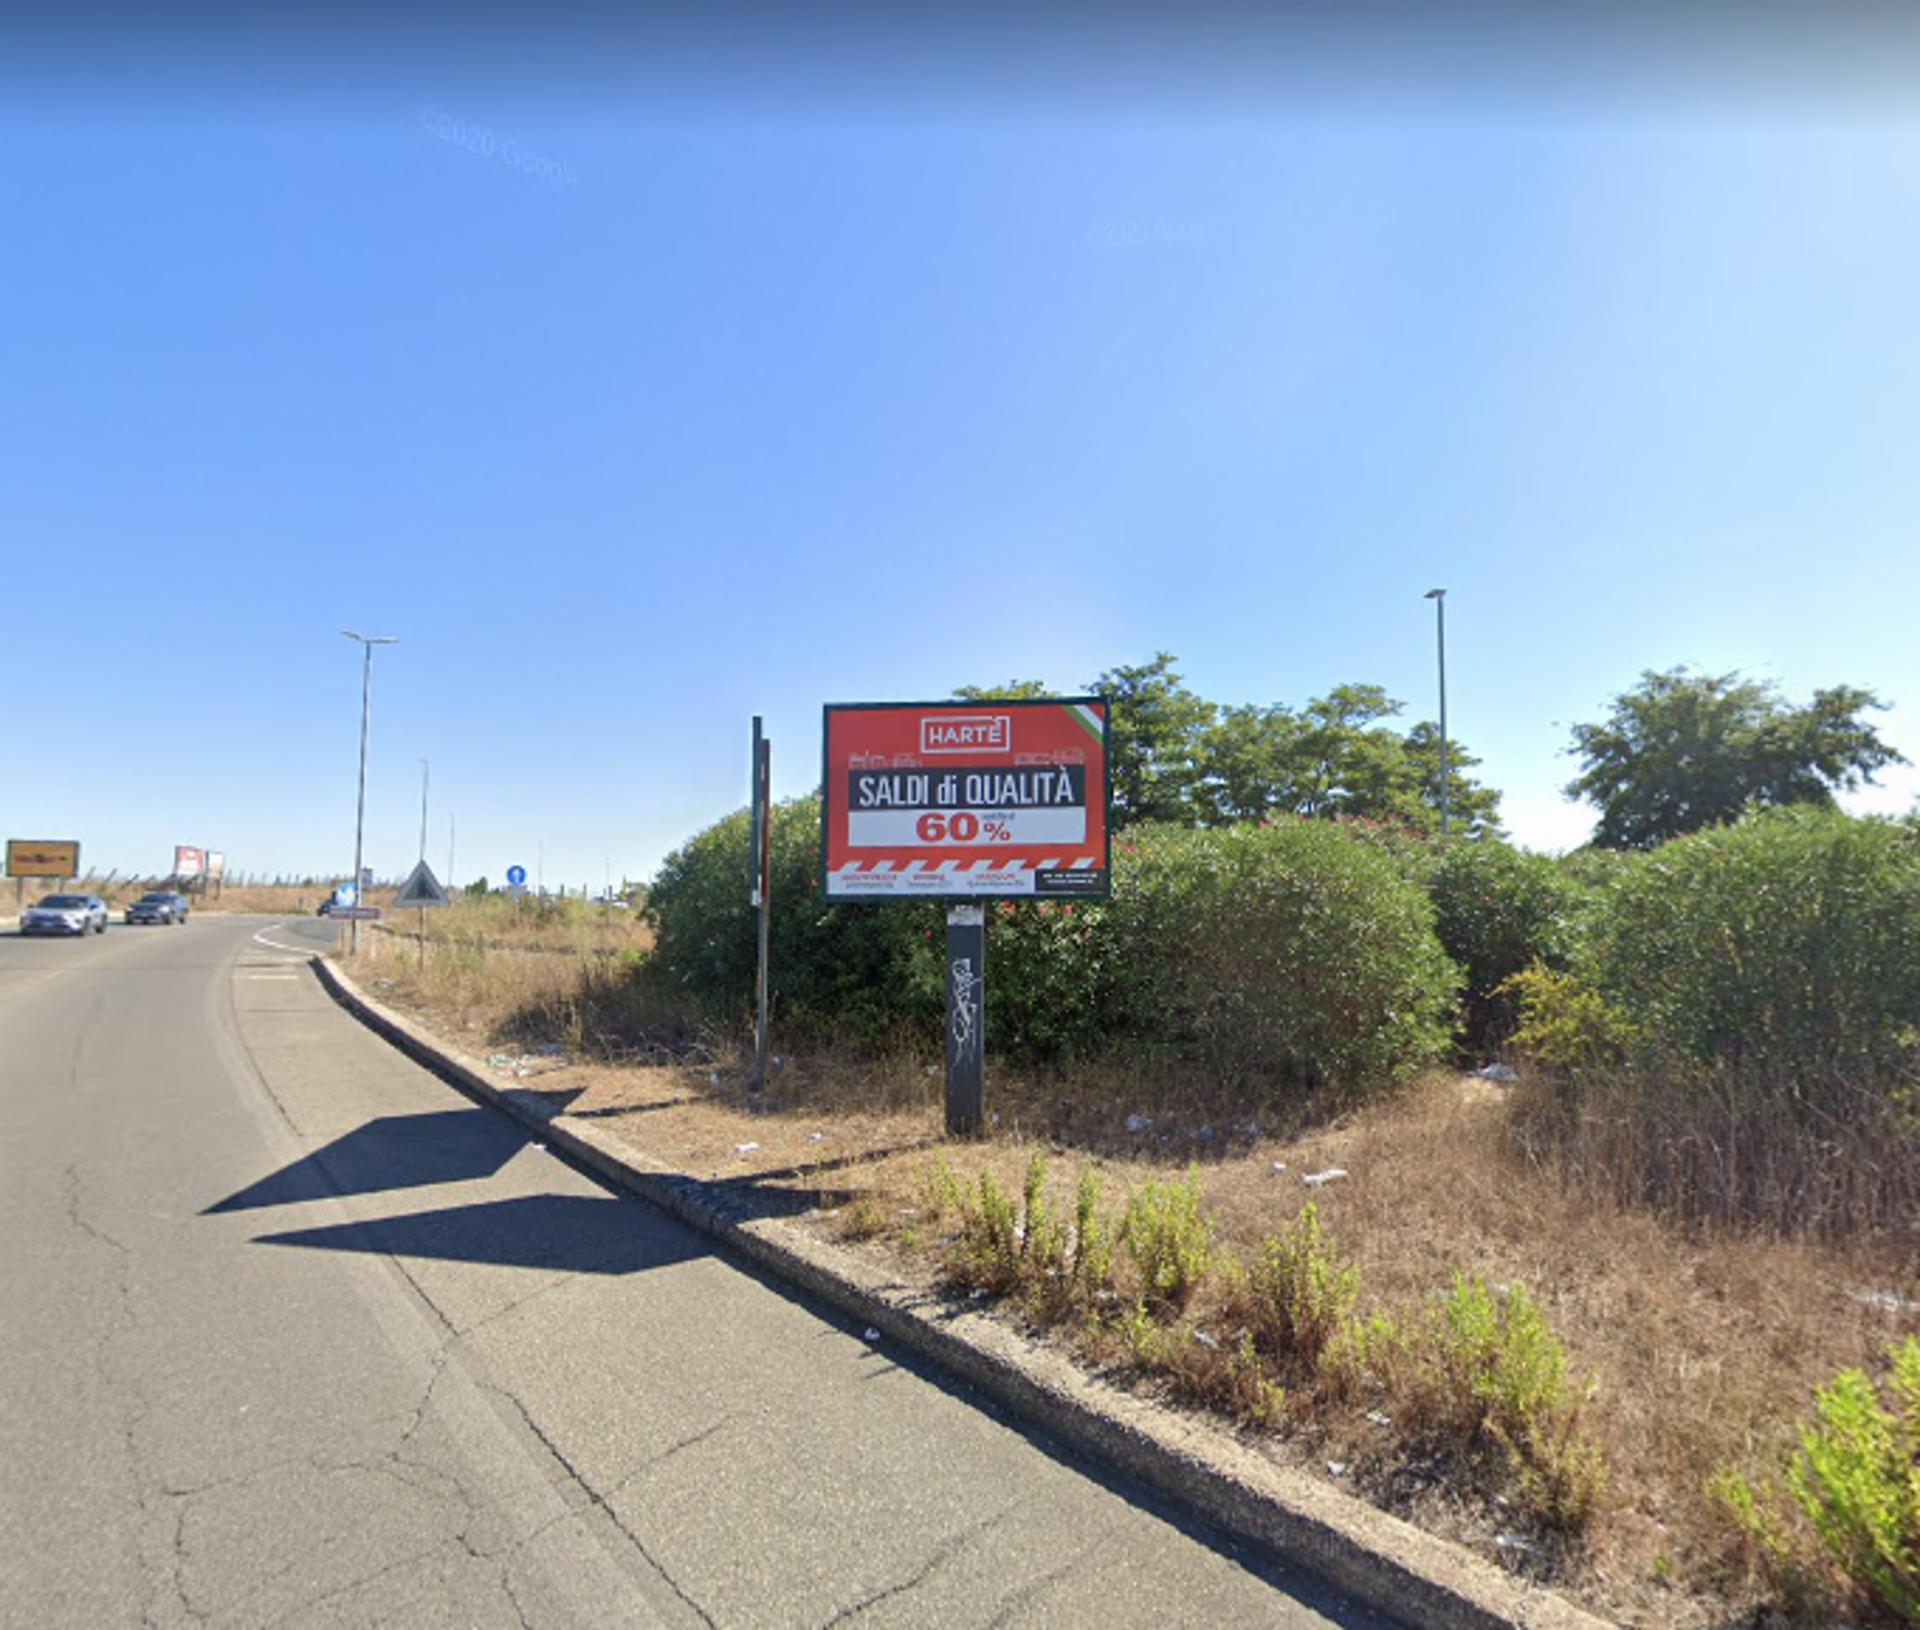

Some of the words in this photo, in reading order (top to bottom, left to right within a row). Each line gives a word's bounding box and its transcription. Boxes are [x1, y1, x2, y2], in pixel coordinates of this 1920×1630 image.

[859, 775, 929, 807] SALDI
[937, 775, 957, 805] di
[965, 764, 1075, 804] QUALITÀ
[916, 812, 979, 842] 60
